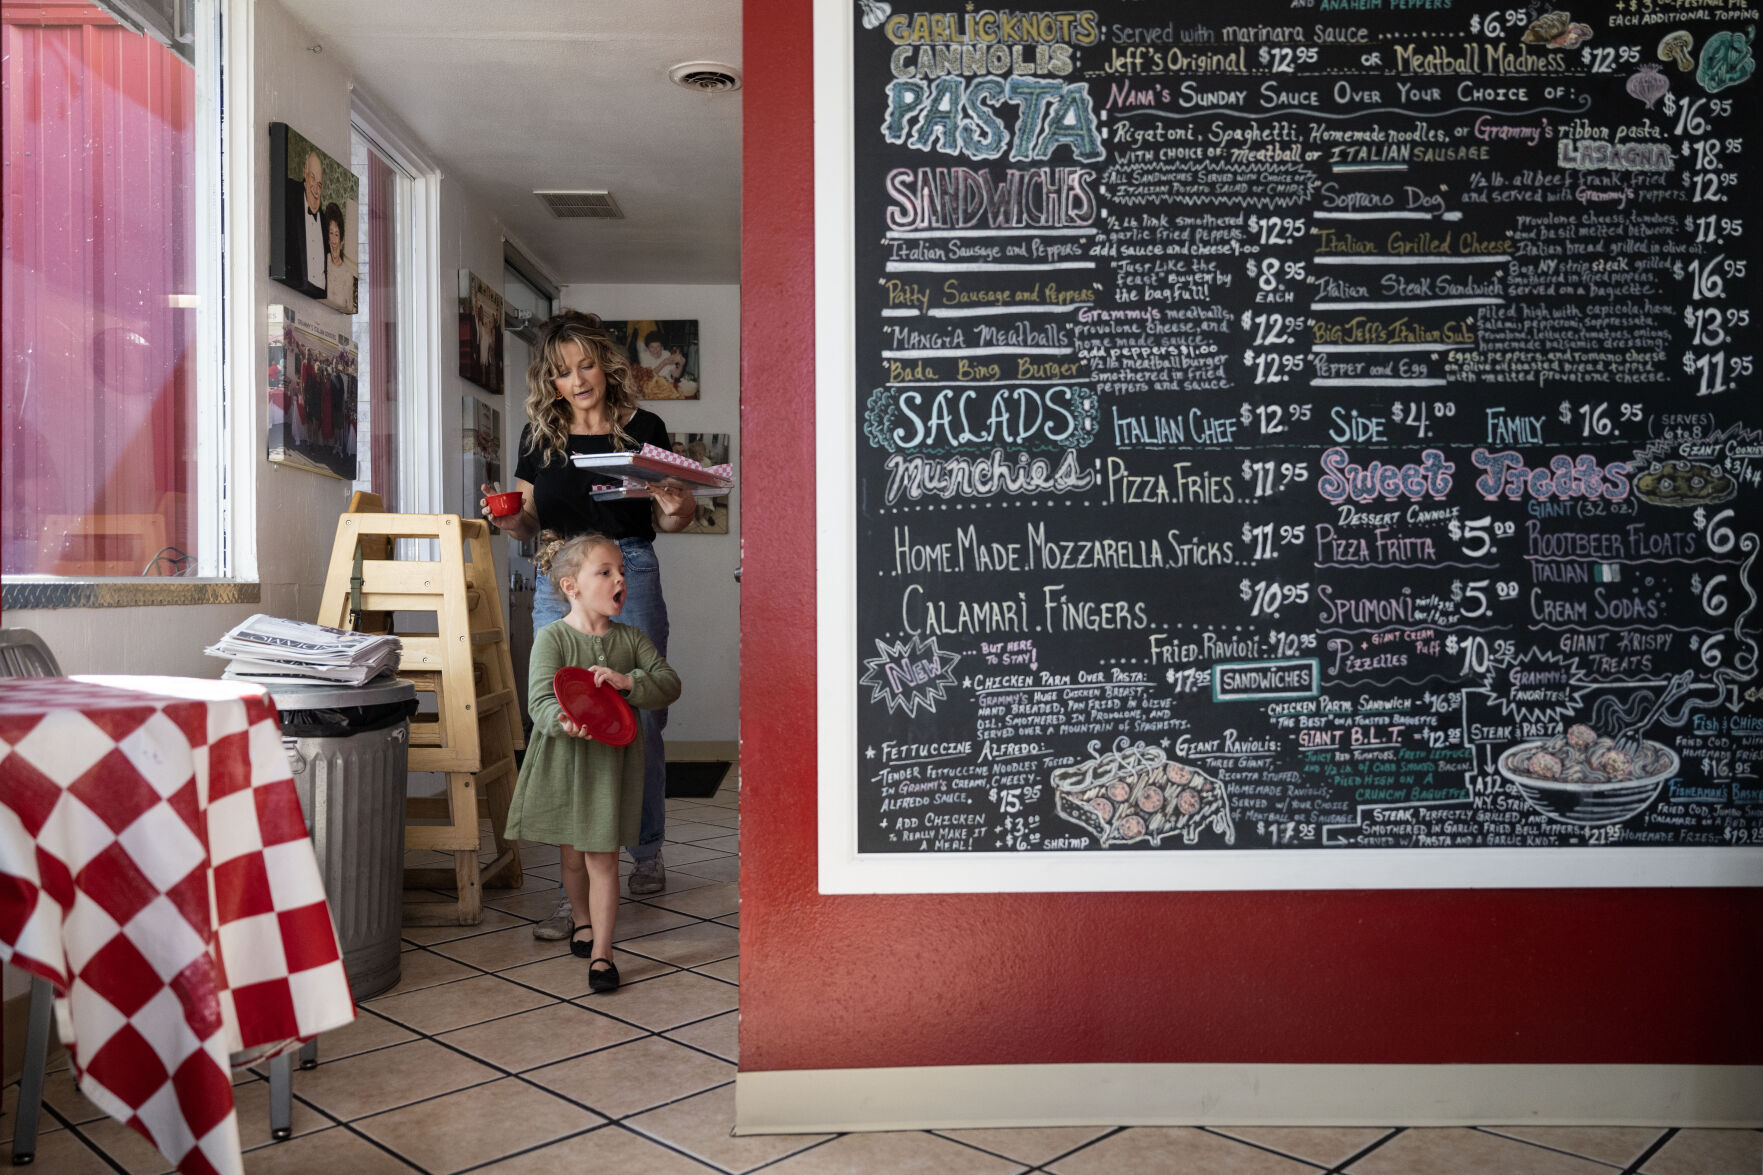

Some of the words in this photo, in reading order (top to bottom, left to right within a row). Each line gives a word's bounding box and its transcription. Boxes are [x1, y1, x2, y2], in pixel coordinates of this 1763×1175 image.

[885, 10, 999, 45] GARLIC
[1112, 21, 1173, 43] Served
[1180, 24, 1214, 43] with
[1222, 25, 1305, 43] marinara
[1470, 9, 1528, 38] $6.95
[1609, 14, 1638, 27] EACH
[1641, 10, 1711, 25] ADDITIONAL
[1105, 47, 1164, 73] Jeff's
[1167, 46, 1246, 73] Original
[1259, 46, 1319, 73] $12.95
[1393, 44, 1480, 73] Meatball
[1484, 43, 1566, 73] Madness
[1581, 46, 1641, 73] $12.95
[1179, 81, 1247, 107] SUNDAY
[1260, 81, 1320, 107] SAUCE
[1334, 81, 1382, 104] OVER
[1458, 81, 1528, 102] CHOICE
[1309, 123, 1386, 143] Homemade
[1474, 115, 1553, 146] Grammy's
[1558, 119, 1609, 139] ribbon
[1663, 91, 1733, 135] $16.95
[1115, 149, 1154, 164] WITH
[1160, 148, 1203, 161] CHOICE
[1329, 144, 1410, 162] ITALIAN
[1413, 146, 1490, 162] SAUSAGE
[1557, 139, 1675, 172] LASAGNA
[1681, 138, 1743, 170] $18.95
[1682, 171, 1738, 202] $12.95
[949, 239, 1001, 261] Sausage
[1006, 242, 1028, 257] and
[1248, 215, 1305, 245] $12.95
[1388, 231, 1450, 254] Grilled
[1684, 214, 1743, 244] $11.95
[1672, 254, 1747, 300] $16.95
[943, 279, 1011, 305] Sausage
[1015, 283, 1040, 302] and
[1144, 286, 1170, 304] bag
[1255, 292, 1294, 303] EACH
[1078, 306, 1161, 323] Grammy's
[1241, 309, 1304, 346] $12.95
[1388, 317, 1441, 344] Italian
[1684, 305, 1749, 346] $13.95
[956, 358, 1001, 381] Bing
[1182, 354, 1229, 371] burger
[1243, 349, 1304, 384] $12.95
[1370, 362, 1393, 375] and
[1683, 350, 1753, 397] $11.95
[1112, 406, 1184, 445] ITALIAN
[1190, 408, 1237, 444] CHEF
[1240, 403, 1312, 434] $12.95
[1391, 401, 1456, 439] $4.00
[1486, 407, 1546, 444] FAMILY
[1559, 401, 1643, 437] $16.95
[1679, 443, 1723, 457] GIANT
[1318, 447, 1455, 500] Sweet
[1471, 448, 1631, 499] Treats
[1528, 500, 1574, 518] GIANT
[1242, 521, 1305, 560] $11.95
[1338, 505, 1401, 526] DESSERT
[1448, 515, 1515, 557] $5.00
[1525, 520, 1624, 557] ROOTBEER
[1627, 523, 1696, 556] FLOATS
[1693, 507, 1735, 553] $6
[1530, 560, 1588, 584] ITALIAN
[1240, 578, 1310, 617] $10.95
[1451, 579, 1519, 618] $5.00
[1530, 587, 1587, 621] CREAM
[1691, 573, 1728, 616] $6
[981, 642, 1002, 654] BUT
[1560, 633, 1610, 651] GIANT
[1689, 633, 1725, 667] $6
[885, 656, 942, 694] NEW
[1589, 654, 1653, 672] TREATS
[974, 675, 1033, 690] CHICKEN
[1040, 672, 1070, 686] PARM
[1268, 701, 1316, 714] CHICKEN
[1300, 730, 1344, 746] GIANT
[1471, 723, 1512, 740] STEAK
[1522, 723, 1564, 737] PASTA
[882, 741, 972, 762] FETTUCCINE
[1176, 735, 1220, 757] GIANT
[992, 761, 1037, 775] NOODLES
[880, 797, 929, 812] ALFREDO
[988, 785, 1042, 813] $15.95
[924, 813, 985, 827] CHICKEN
[1362, 822, 1427, 835] SMOTHERED
[1419, 809, 1473, 821] PERFECTLY
